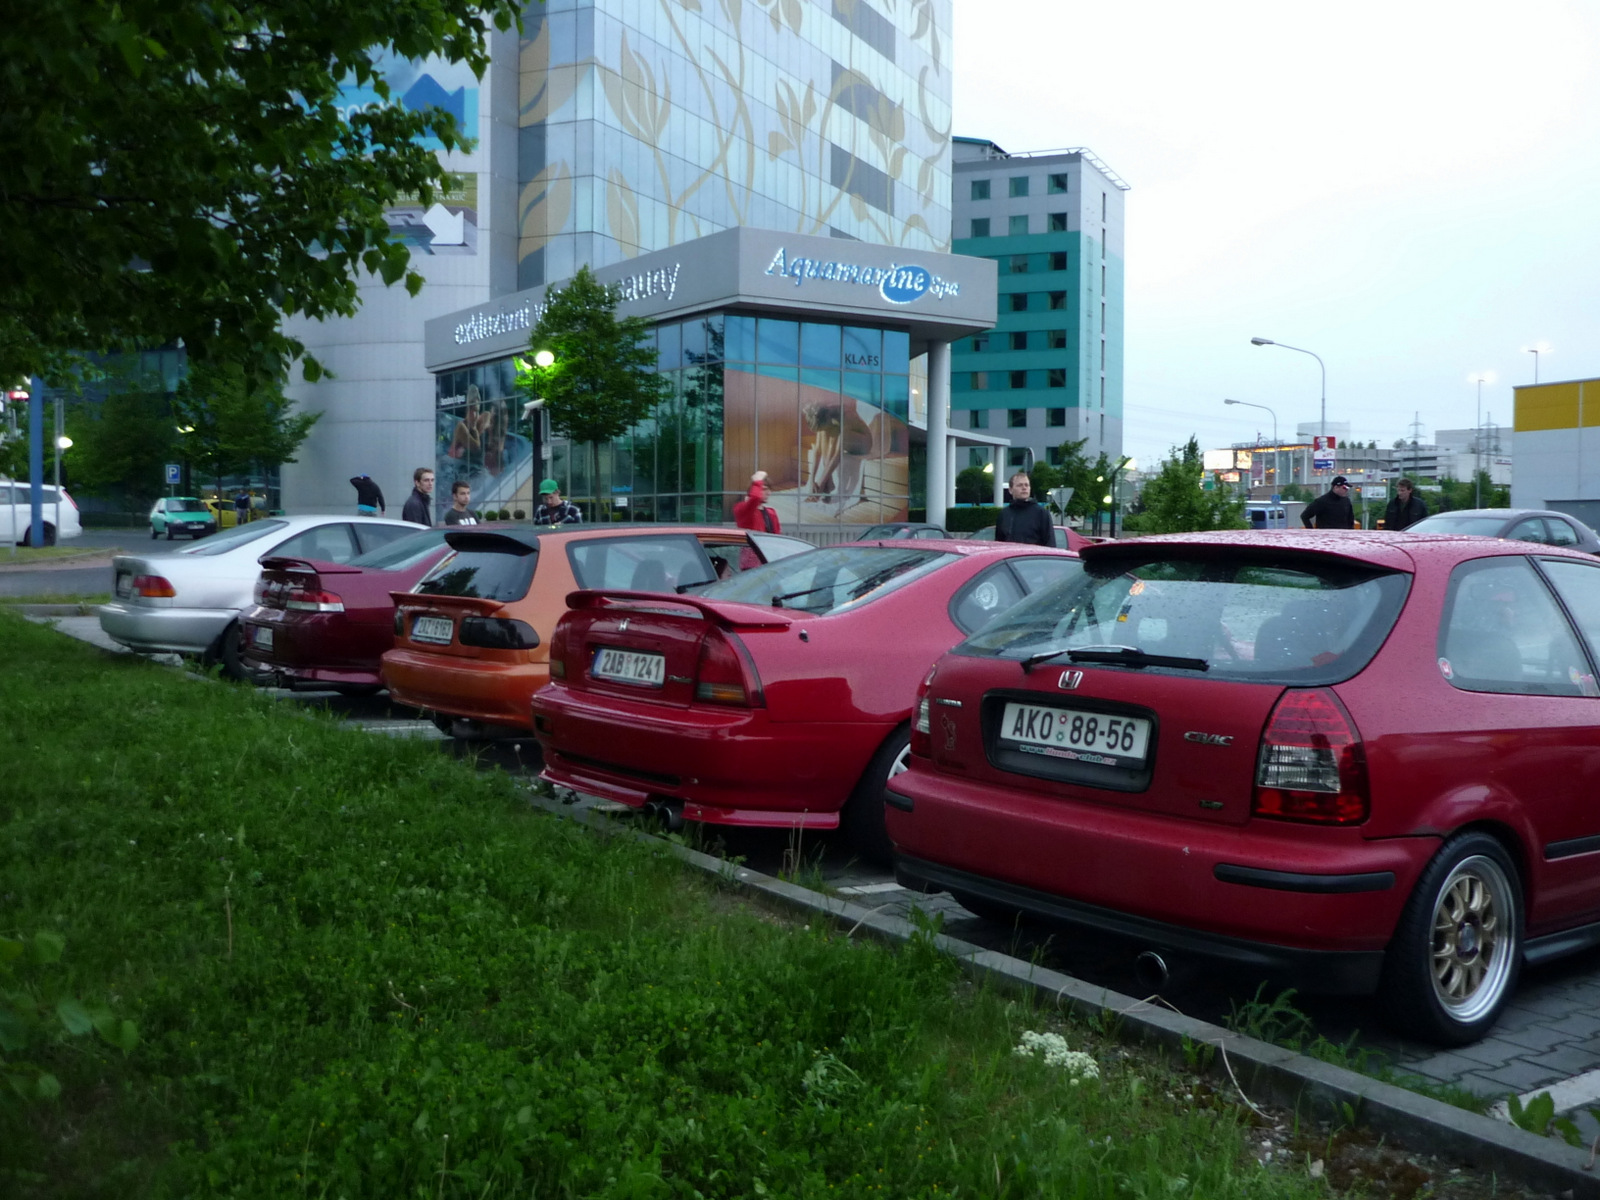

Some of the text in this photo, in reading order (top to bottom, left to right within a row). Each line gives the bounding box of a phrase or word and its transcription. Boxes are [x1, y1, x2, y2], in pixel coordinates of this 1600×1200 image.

[764, 247, 961, 299] Aquamarine Spa
[844, 353, 879, 367] KLAFS
[169, 467, 177, 478] P
[1070, 715, 1136, 752] 88-56
[1184, 731, 1235, 747] CIVIC
